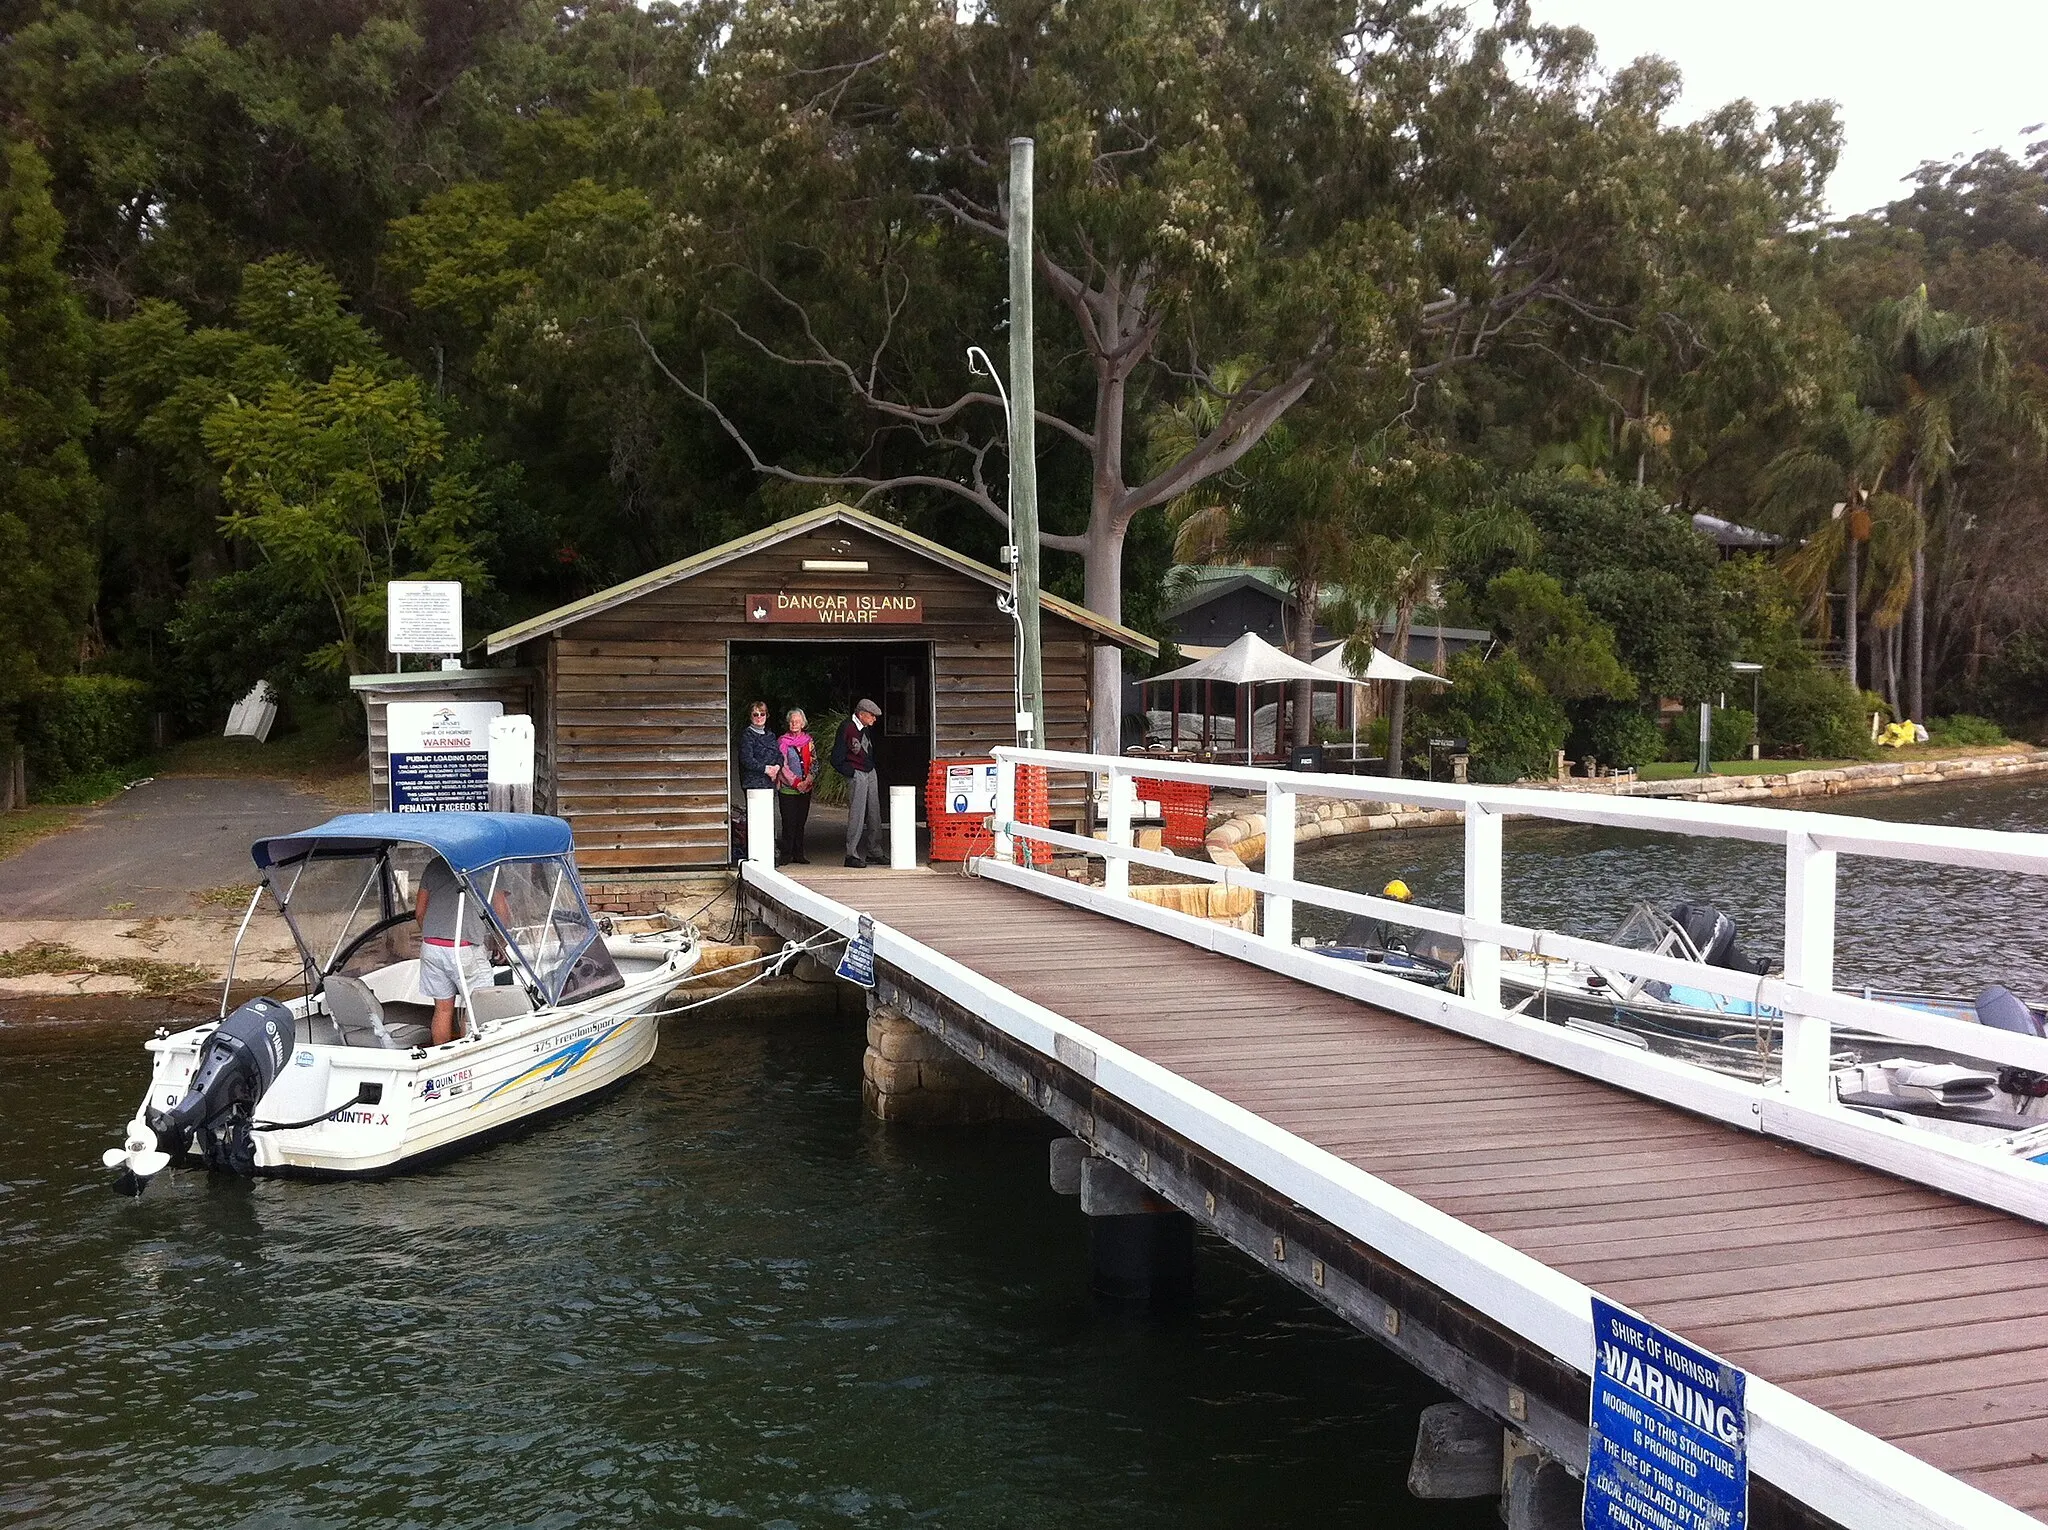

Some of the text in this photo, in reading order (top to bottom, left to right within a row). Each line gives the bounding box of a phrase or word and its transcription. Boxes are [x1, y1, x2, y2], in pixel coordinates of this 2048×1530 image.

[777, 595, 917, 610] DANGAR ISLAND
[818, 610, 878, 623] WHARF
[423, 738, 471, 746] WARNING
[434, 754, 465, 762] LOADING
[399, 803, 437, 812] PENALTY
[439, 802, 476, 811] EXCEEDS
[435, 1068, 473, 1088] QUINTREX
[328, 1110, 390, 1126] QUINTRX
[1611, 1318, 1720, 1393] SHIRE OF HORNSBY
[1602, 1340, 1738, 1443] WARNING
[1602, 1390, 1735, 1480] MOORING TO THIS STRUCTURE
[1633, 1428, 1697, 1478] IS PROHIBITED
[1597, 1475, 1623, 1502] LOCAL
[1603, 1436, 1731, 1527] THE USE OF THIS STRUCTURE
[1678, 1504, 1691, 1524] BY
